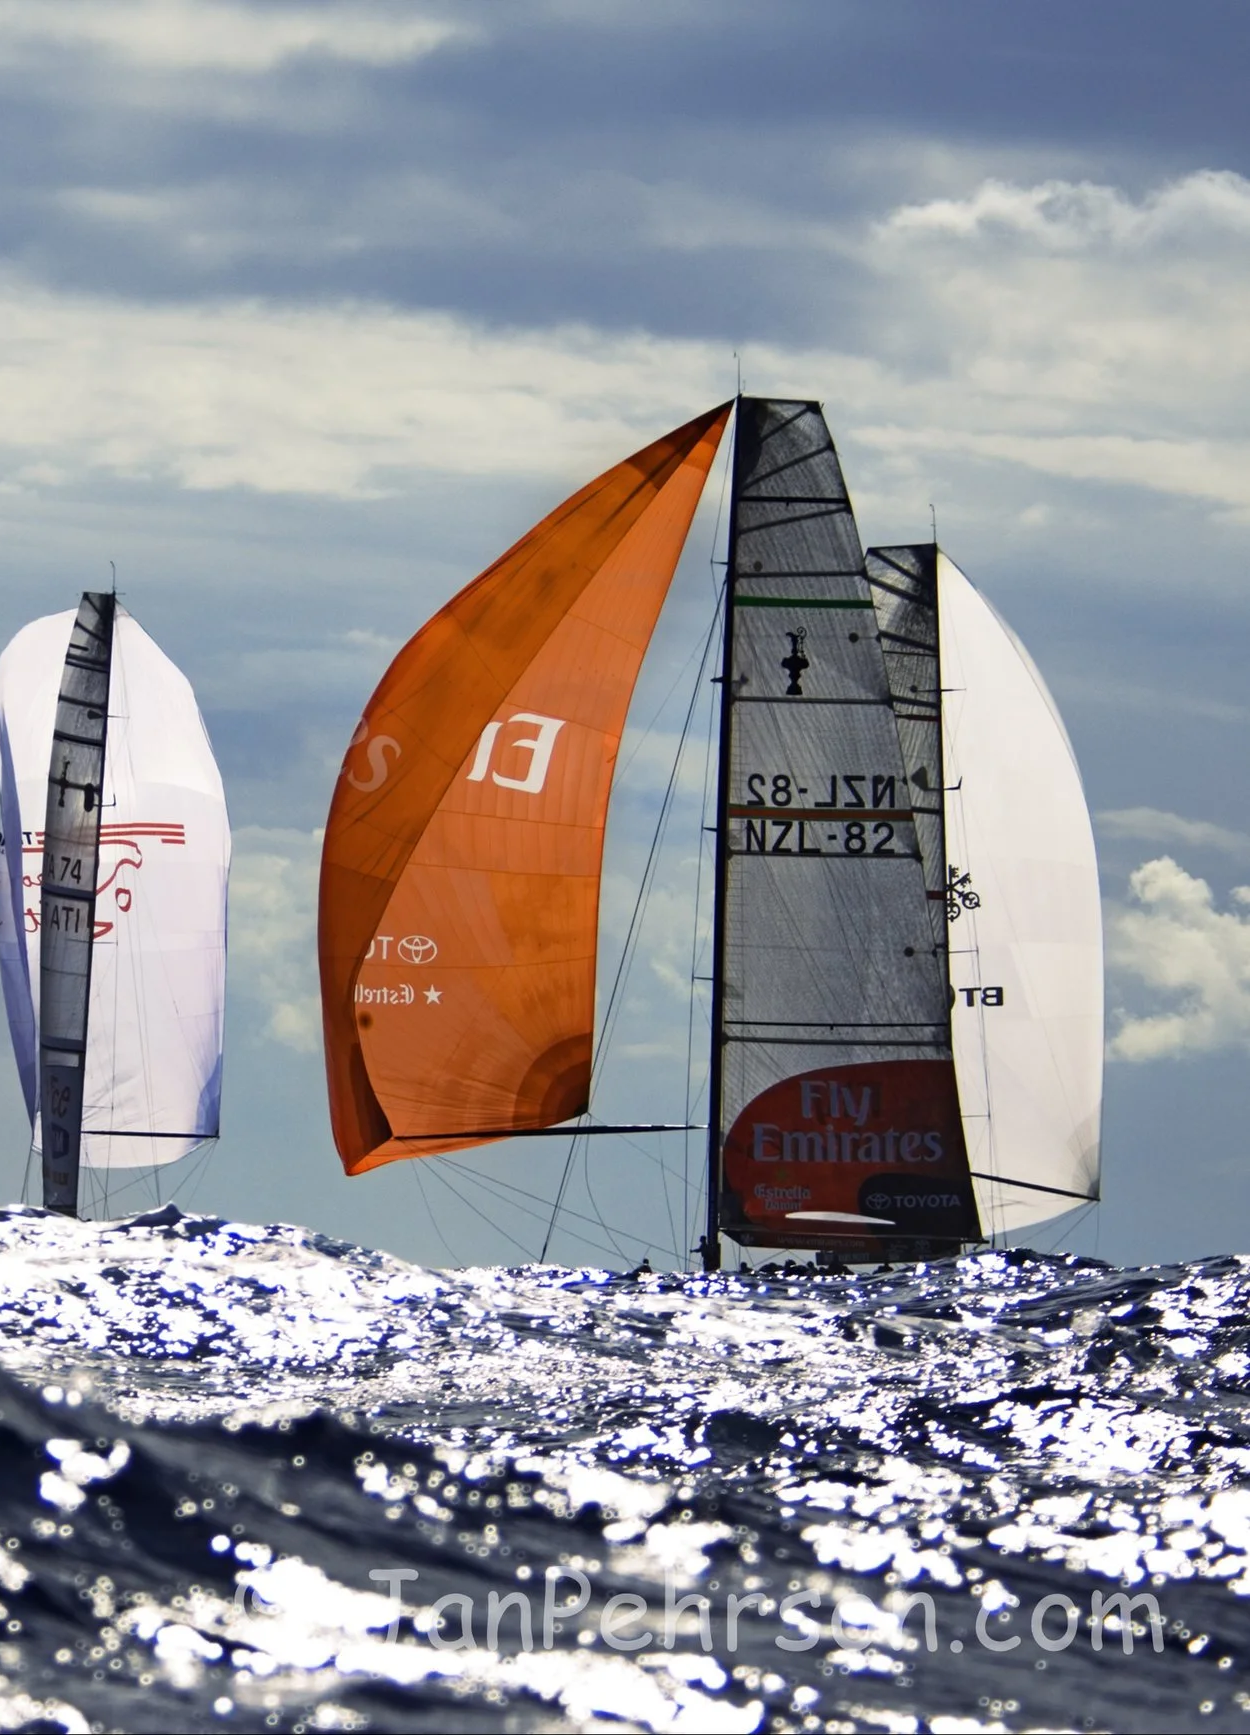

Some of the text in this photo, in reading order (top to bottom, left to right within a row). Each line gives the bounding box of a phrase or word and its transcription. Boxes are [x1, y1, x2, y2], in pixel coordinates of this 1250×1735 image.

[61, 856, 82, 885] 74
[799, 1080, 871, 1126] Fly
[751, 1123, 943, 1163] Emirates
[754, 1183, 812, 1200] Estrella
[892, 1194, 962, 1209] TOYOTA
